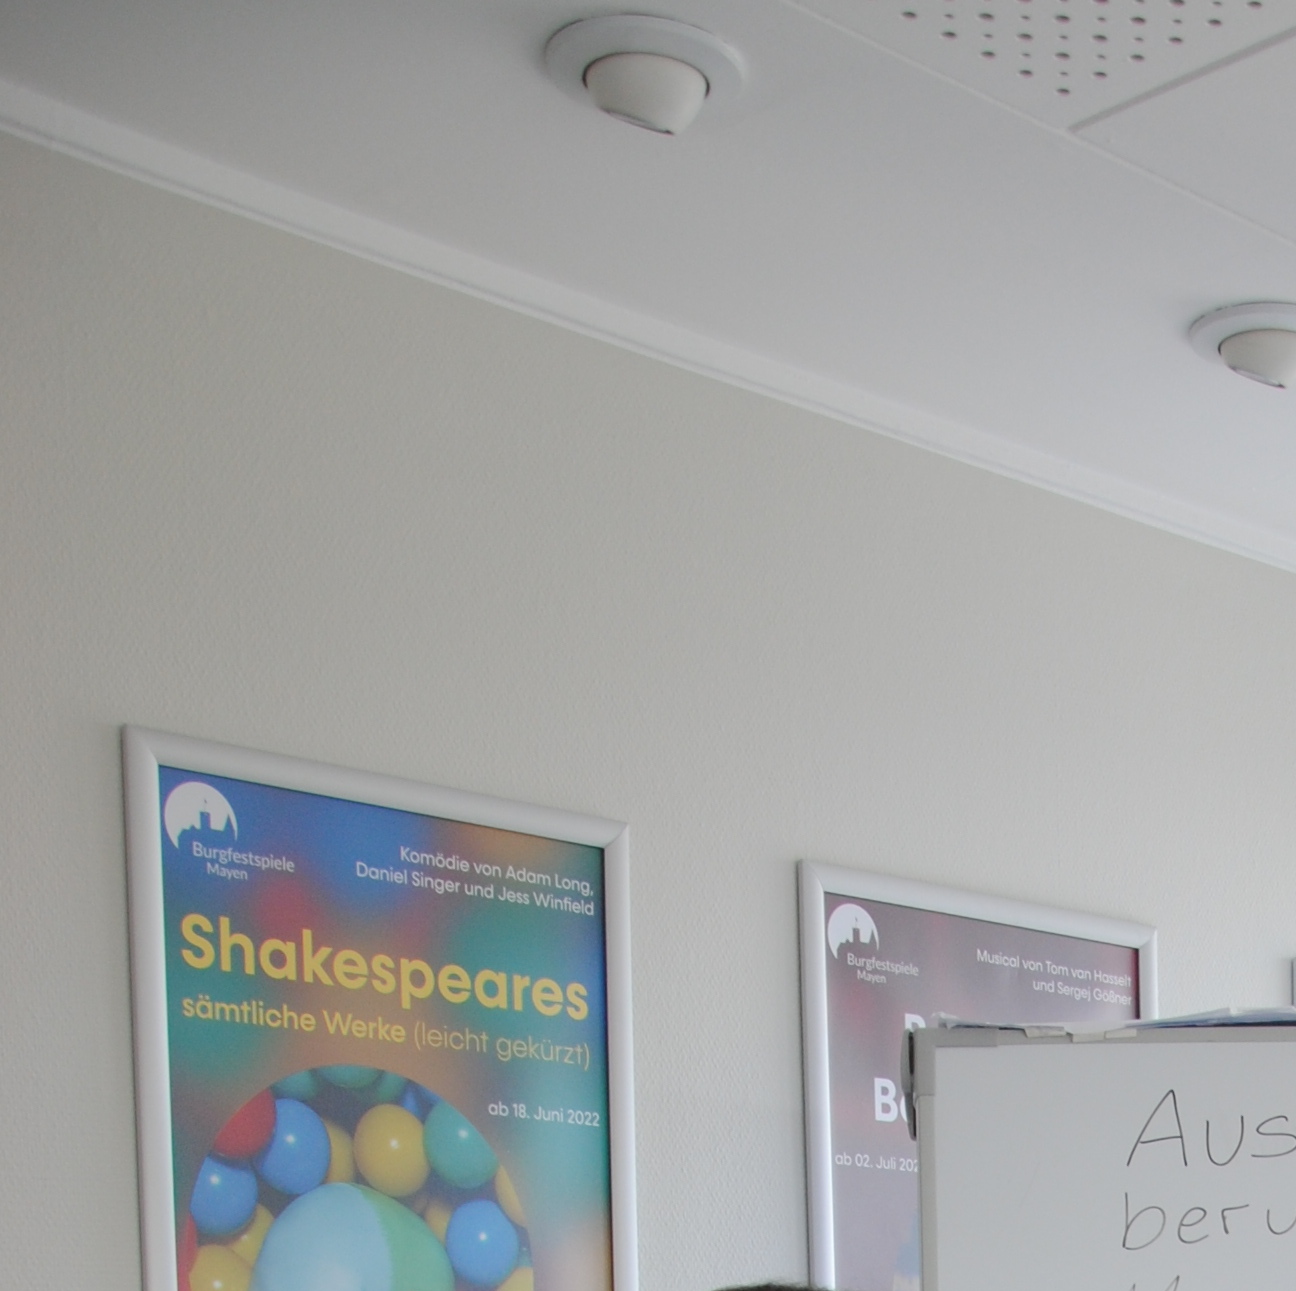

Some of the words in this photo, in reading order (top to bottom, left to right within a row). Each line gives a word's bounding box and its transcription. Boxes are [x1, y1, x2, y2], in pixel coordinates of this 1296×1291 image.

[192, 841, 295, 873] Burgfestspiele
[206, 862, 248, 880] Mayen
[400, 845, 470, 872] Komödie
[473, 861, 502, 878] von
[505, 865, 551, 886] Adam
[554, 874, 594, 897] Long,
[356, 861, 408, 885] Daniel
[412, 871, 460, 894] Singer
[464, 882, 494, 899] und
[497, 887, 530, 904] Jess
[533, 892, 594, 916] Winfield
[180, 913, 589, 1021] Shakespeares
[847, 953, 919, 977] Burgfestspiele
[857, 969, 887, 984] Mayen
[976, 948, 1020, 968] Musical
[1022, 959, 1043, 972] von
[1045, 960, 1069, 977] Tom
[1070, 968, 1091, 981] van
[1093, 970, 1132, 988] Hasselt
[1033, 980, 1055, 993] und
[1057, 982, 1091, 1001] Sergej
[182, 994, 316, 1032] sämtliche
[322, 1009, 406, 1044] Werke
[413, 1020, 488, 1054] (leicht
[495, 1035, 591, 1071] gekürzt)
[488, 1101, 509, 1117] ab
[513, 1104, 531, 1120] 18.
[533, 1106, 564, 1123] Juni
[567, 1109, 600, 1127] 2022
[835, 1152, 852, 1166] ab
[855, 1153, 874, 1168] 02.
[876, 1156, 897, 1170] Juli
